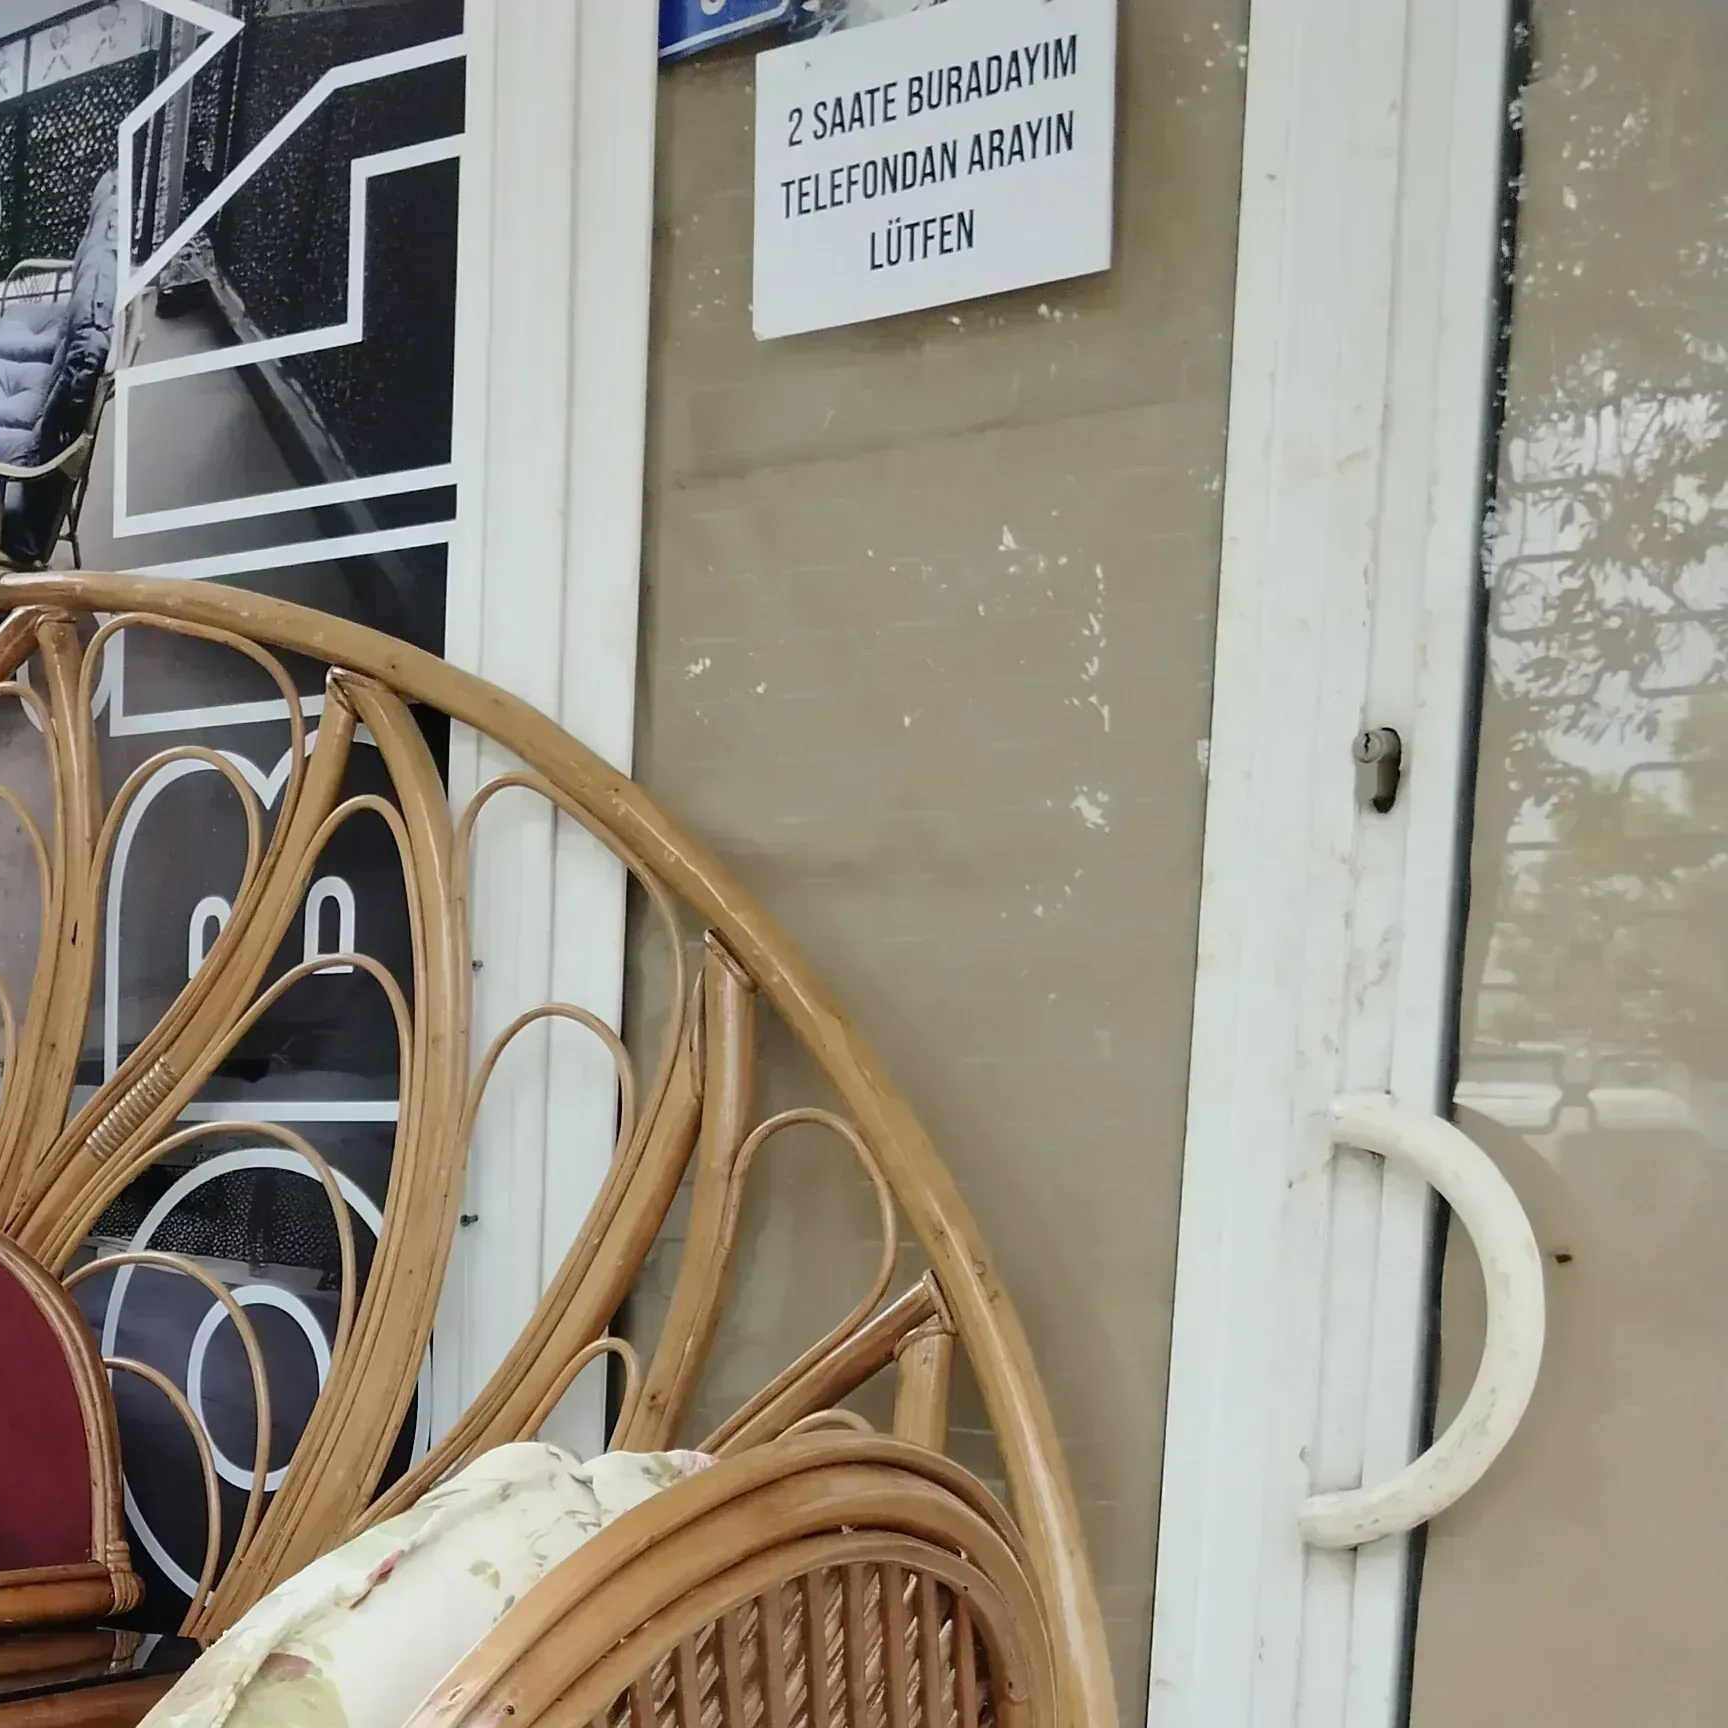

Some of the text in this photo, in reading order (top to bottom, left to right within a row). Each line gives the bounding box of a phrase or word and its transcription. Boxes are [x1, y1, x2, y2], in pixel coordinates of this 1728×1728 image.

[788, 33, 1078, 147] 2 SAATE BURADAYIM
[780, 110, 1074, 219] TELEFONDAN ARAYIN
[870, 209, 975, 271] LÜTFEN
